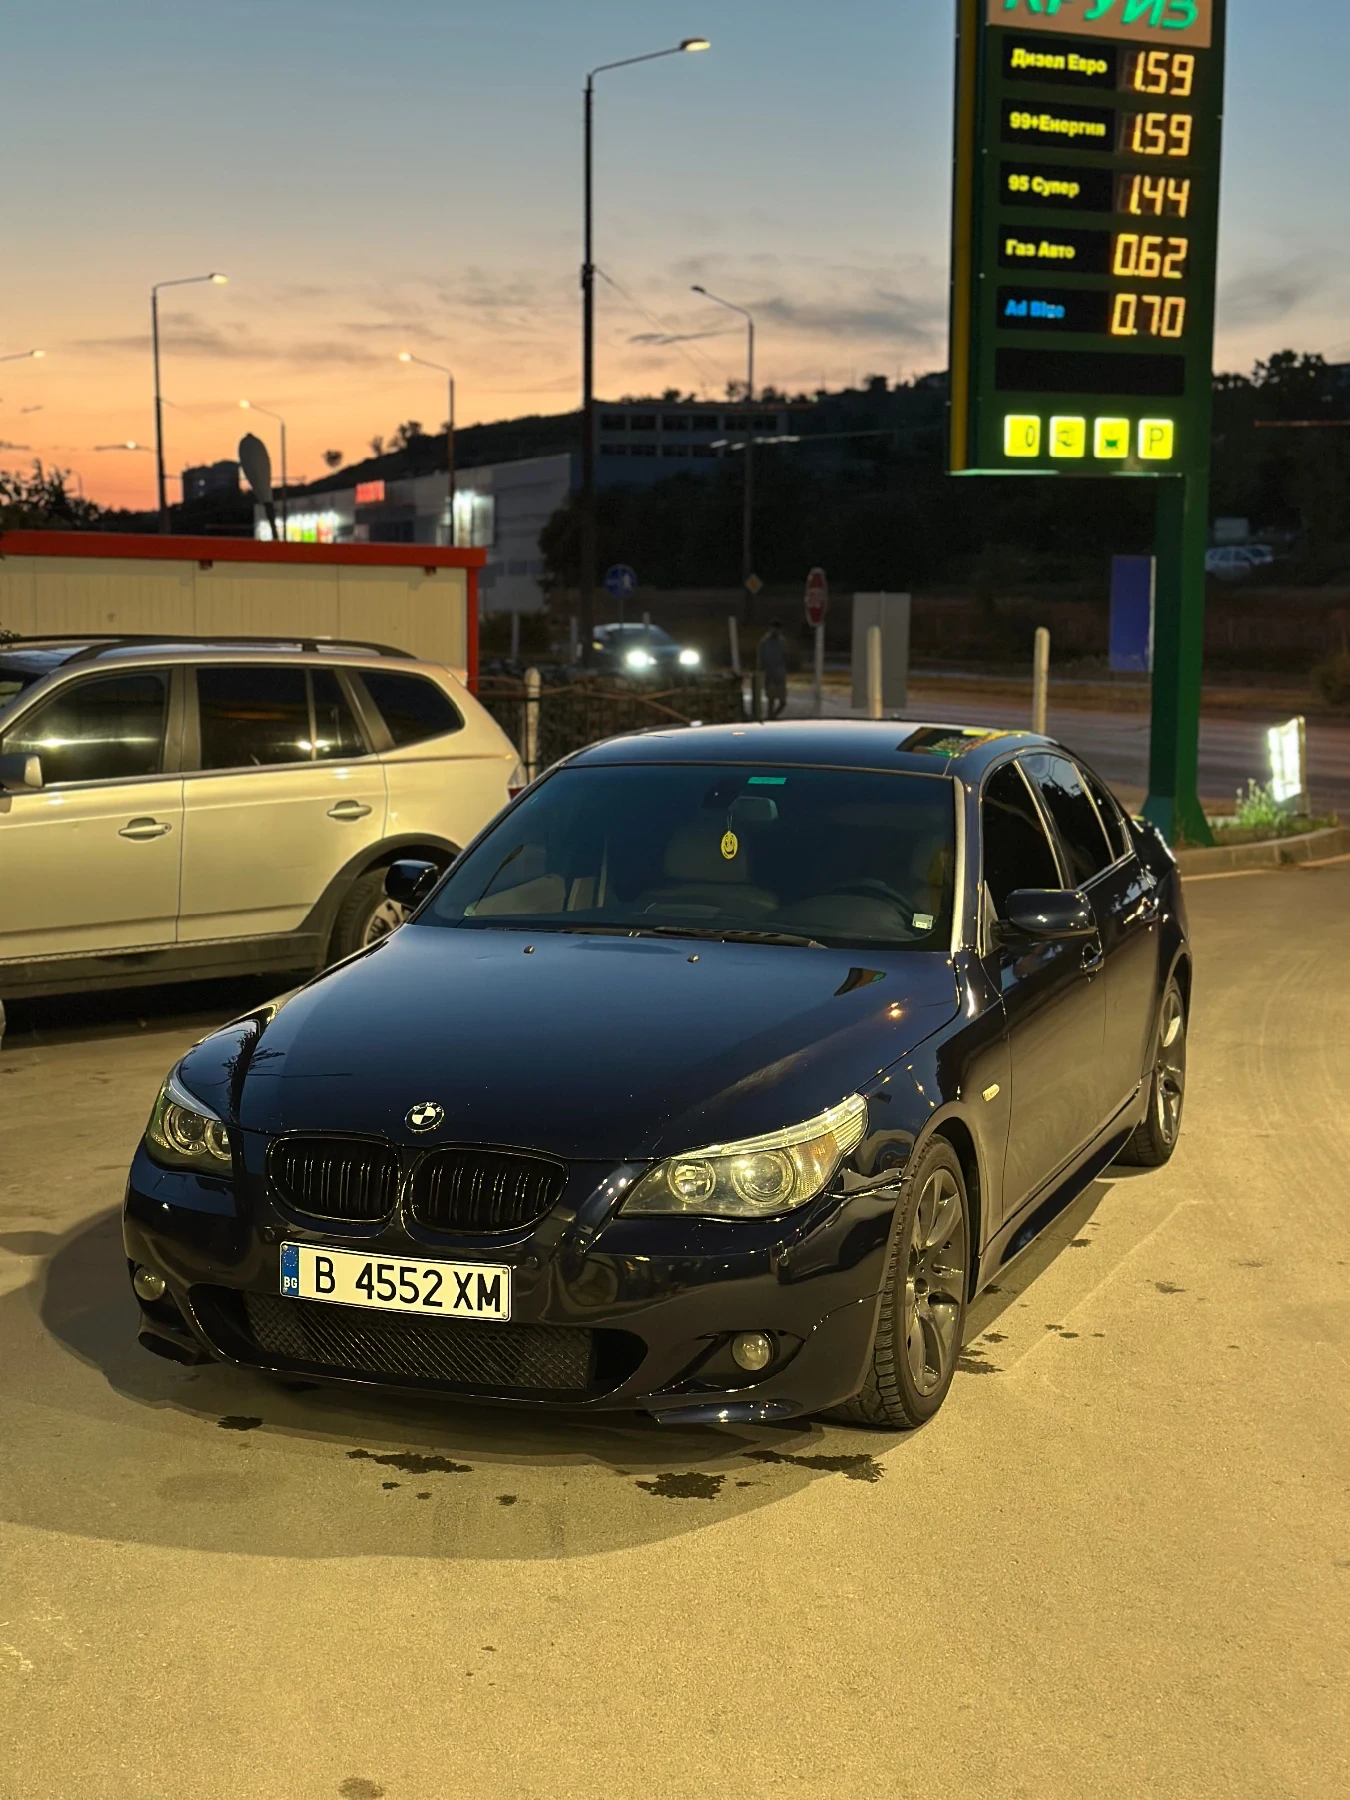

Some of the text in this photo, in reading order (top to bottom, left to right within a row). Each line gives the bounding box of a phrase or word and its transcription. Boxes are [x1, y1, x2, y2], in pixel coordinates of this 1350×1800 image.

[1011, 48, 1195, 97] Дизел Евро 1.59
[1132, 112, 1193, 156] 1.59
[1008, 174, 1191, 218] 95 Супер 1.44
[1005, 233, 1188, 279] Газ Авто 0.62
[1004, 293, 1186, 338] Ad Blue 0.70
[283, 1275, 298, 1289] BG
[315, 1256, 501, 1313] B 4552 XM
